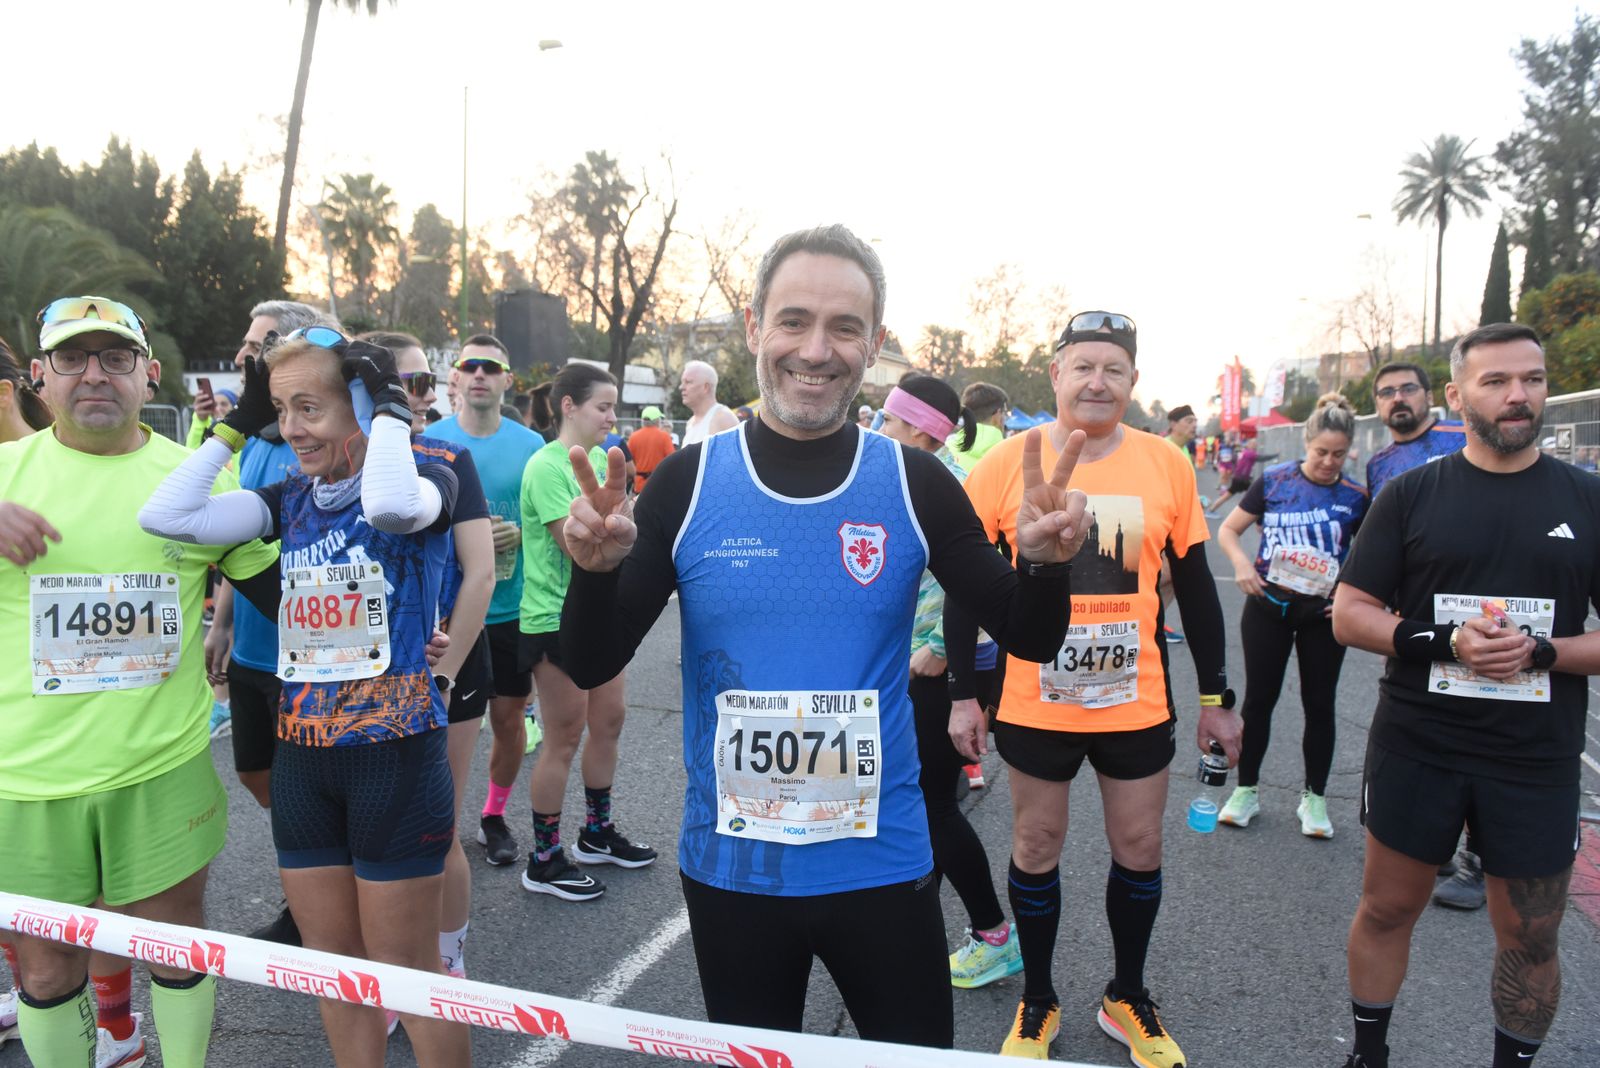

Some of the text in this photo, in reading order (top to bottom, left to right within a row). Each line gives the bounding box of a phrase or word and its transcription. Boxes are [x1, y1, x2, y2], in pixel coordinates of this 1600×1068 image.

[1281, 507, 1329, 527] MARATÓN
[848, 526, 876, 537] Atletica
[721, 537, 762, 547] ATLETICA
[703, 549, 779, 559] SANGIOVANNESE
[731, 559, 749, 568] 1967
[846, 556, 881, 580] SANGIOVANNESE
[1280, 550, 1328, 574] 14355
[326, 565, 366, 582] SEVILLA
[40, 576, 102, 588] MEDIO MARATÓN
[123, 574, 161, 589] SEVILLA
[1073, 601, 1130, 614] co jubilado
[1459, 598, 1487, 608] MARAT
[1504, 599, 1539, 613] SEVILLA
[284, 592, 363, 630] 14887
[44, 600, 155, 638] 14891
[1101, 623, 1128, 637] SEVILLA
[1053, 644, 1125, 672] 13478
[97, 676, 119, 684] HOKA
[725, 694, 788, 710] MEDIO MARATÓN
[812, 694, 857, 714] SEVILLA
[728, 729, 848, 775] 15071
[771, 777, 806, 785] Massimo
[779, 793, 798, 801] Parigi
[188, 803, 218, 832] HOK
[783, 826, 806, 835] HOKA
[430, 986, 512, 1009] Acción Creativa de Eventos
[626, 1023, 725, 1048] Acción Creativa de Eventos
